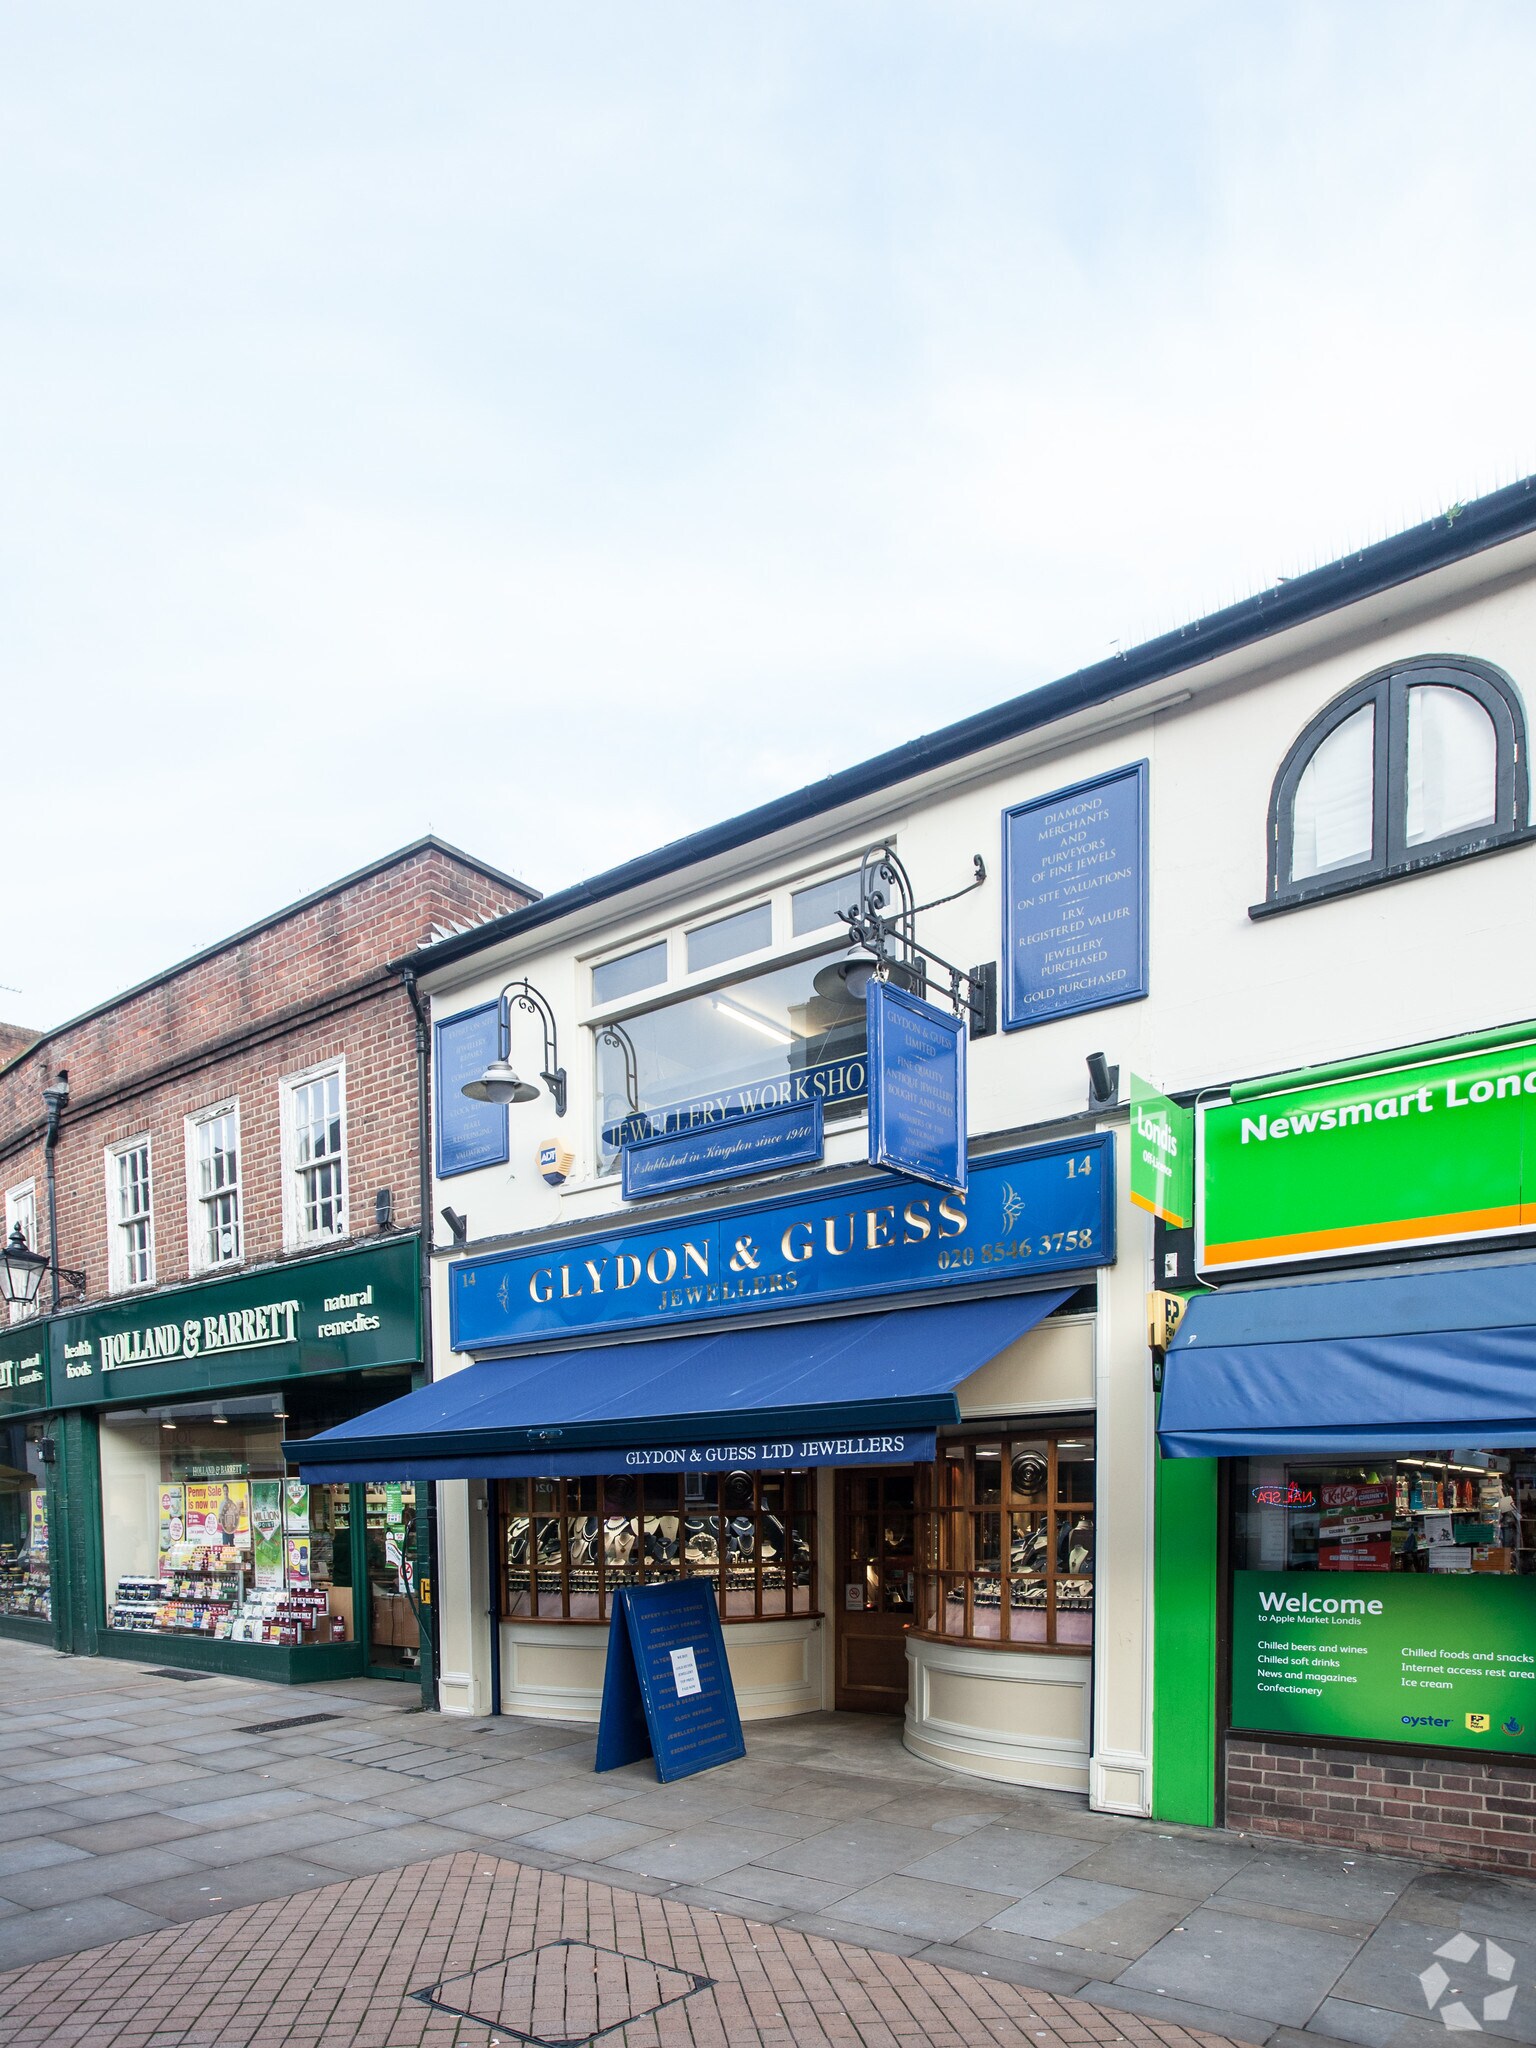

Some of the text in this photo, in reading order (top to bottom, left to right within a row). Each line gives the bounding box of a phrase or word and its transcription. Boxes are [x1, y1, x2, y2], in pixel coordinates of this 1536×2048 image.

[1038, 808, 1110, 842] MERCHANTS
[1043, 798, 1103, 826] DIAMOND
[1060, 830, 1087, 848] AND
[1031, 848, 1116, 884] OF FINE JEWELS
[1041, 838, 1105, 868] PURVEYORS
[1017, 867, 1132, 911] ON SITE VALUATIONS
[1018, 906, 1130, 947] REGISTERED VALUER
[1041, 950, 1108, 977] PURCHASED
[1044, 937, 1103, 964] JEWELLERY
[1023, 968, 1127, 1004] GOLD PURCHASED
[887, 1009, 952, 1050] GLYDON & GUESS
[905, 1035, 936, 1057] LIMITED
[897, 1055, 944, 1084] FINE QUALITY
[738, 1061, 868, 1116] WORKSHO
[886, 1067, 955, 1104] ANTIQUE JEWELLERY
[888, 1083, 953, 1118] BOUGHT AND SOLD
[1241, 1087, 1433, 1144] Newsmart
[1137, 1106, 1178, 1157] Londis
[541, 1150, 556, 1162] ADT
[634, 1126, 812, 1175] Established in Kingston since 1940
[1066, 1155, 1092, 1179] 14
[529, 1193, 968, 1303] GLYDON & GUESS
[937, 1228, 1093, 1270] 020 8546 3758
[462, 1272, 476, 1288] 14
[658, 1270, 798, 1311] JEWELLERS
[324, 1285, 374, 1312] natural
[100, 1300, 299, 1371] HOLLAND & BARRETT
[318, 1313, 380, 1338] remedies
[66, 1361, 92, 1379] foods
[626, 1436, 904, 1466] GLYDON & GUESS LTD JEWELLERS
[187, 1486, 222, 1499] Penny Sale
[188, 1499, 218, 1509] is now on
[1327, 1486, 1354, 1504] KitKat
[254, 1511, 279, 1521] MILLION
[1258, 1591, 1384, 1615] Welcome
[1258, 1614, 1362, 1625] to Apple Market Londis
[1257, 1641, 1368, 1654] Chilled beers and wines
[1401, 1648, 1534, 1663] Chilled foods and snacks
[1257, 1655, 1340, 1668] Chilled soft drinks
[1401, 1662, 1535, 1679] Internet access rest area
[1257, 1669, 1357, 1683] News and magazines
[1401, 1677, 1453, 1689] Ice cream
[1257, 1683, 1322, 1697] Confectionery
[1401, 1715, 1451, 1727] oyster
